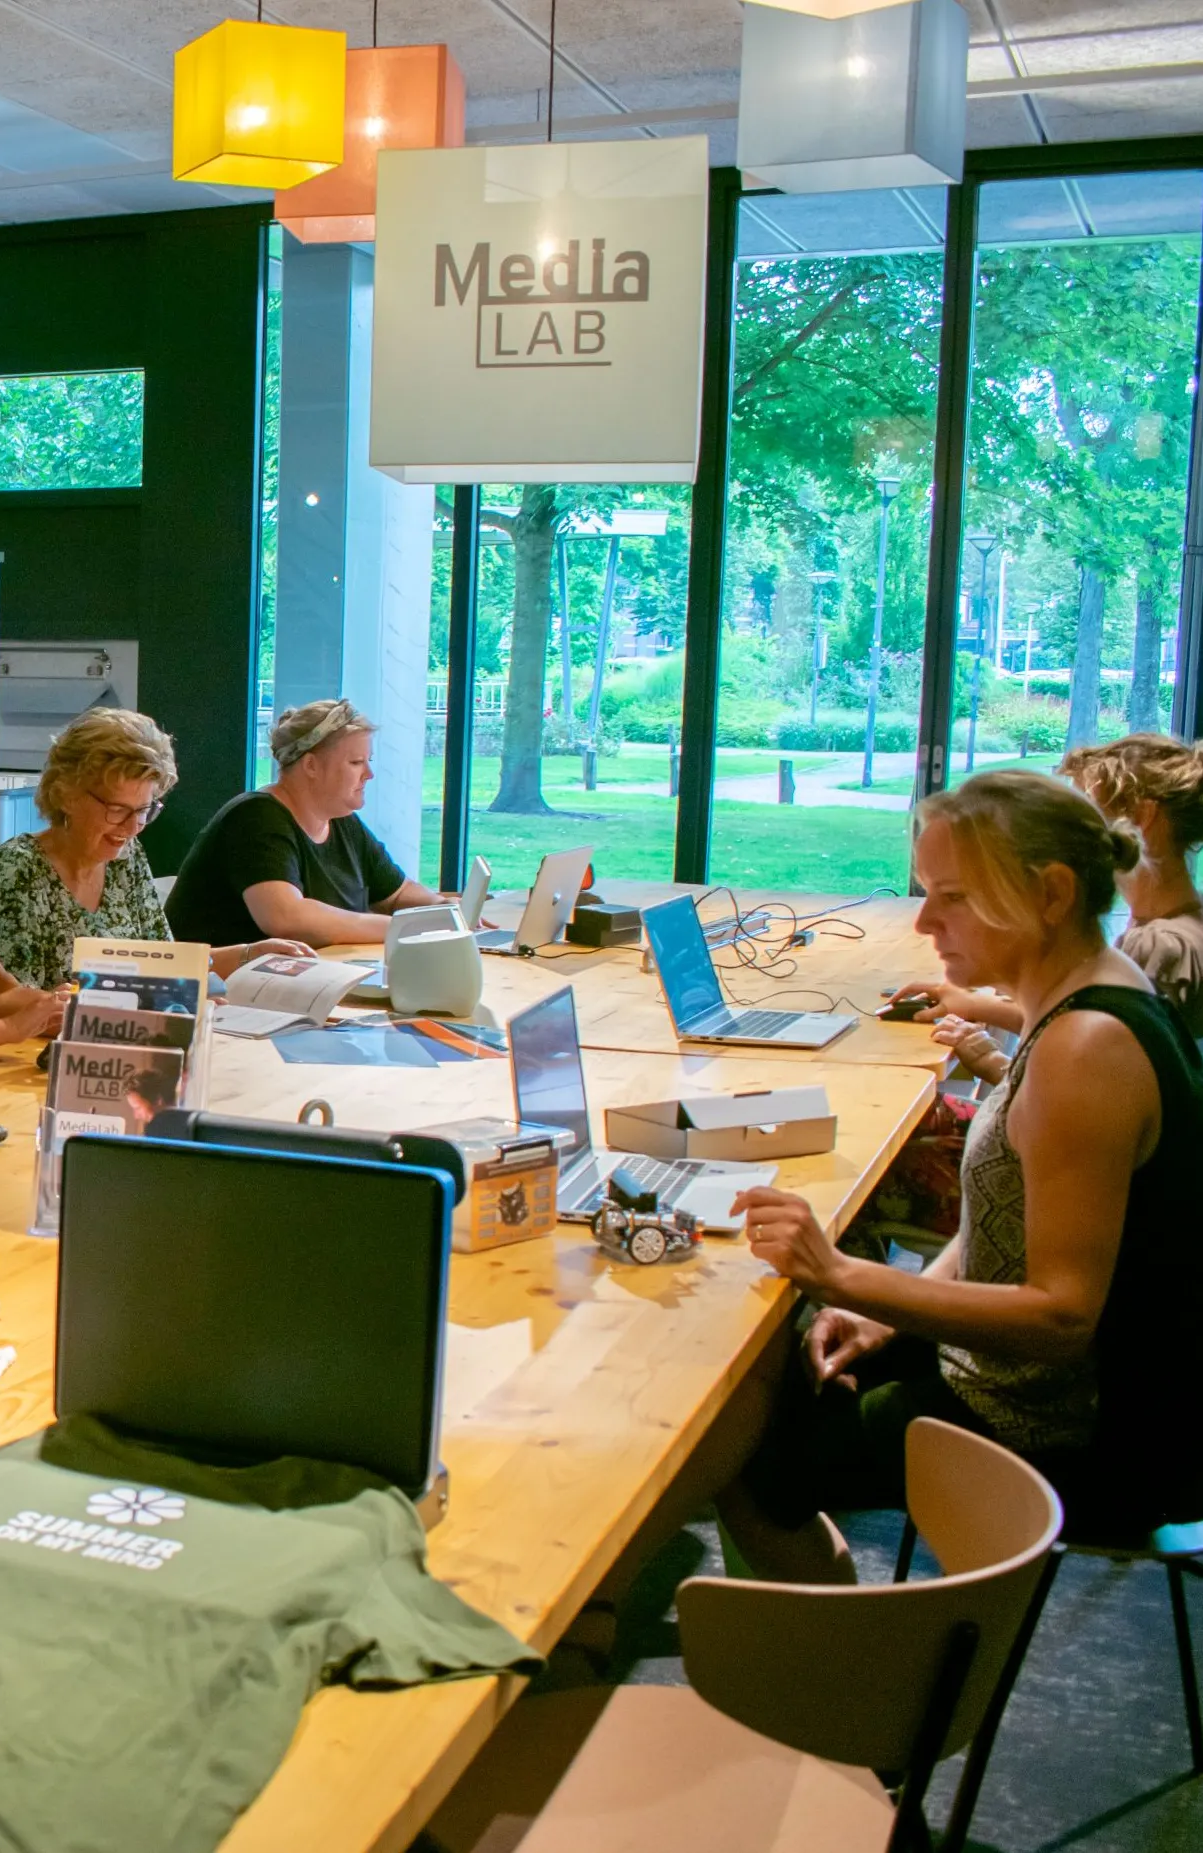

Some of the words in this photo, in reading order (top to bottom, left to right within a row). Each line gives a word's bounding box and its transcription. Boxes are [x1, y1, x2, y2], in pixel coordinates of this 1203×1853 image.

[434, 238, 650, 307] Media
[494, 309, 607, 357] LAB
[83, 1079, 120, 1098] LAB
[8, 1511, 184, 1560] SUMMER
[33, 1534, 87, 1553] MY
[81, 1545, 164, 1571] MIND
